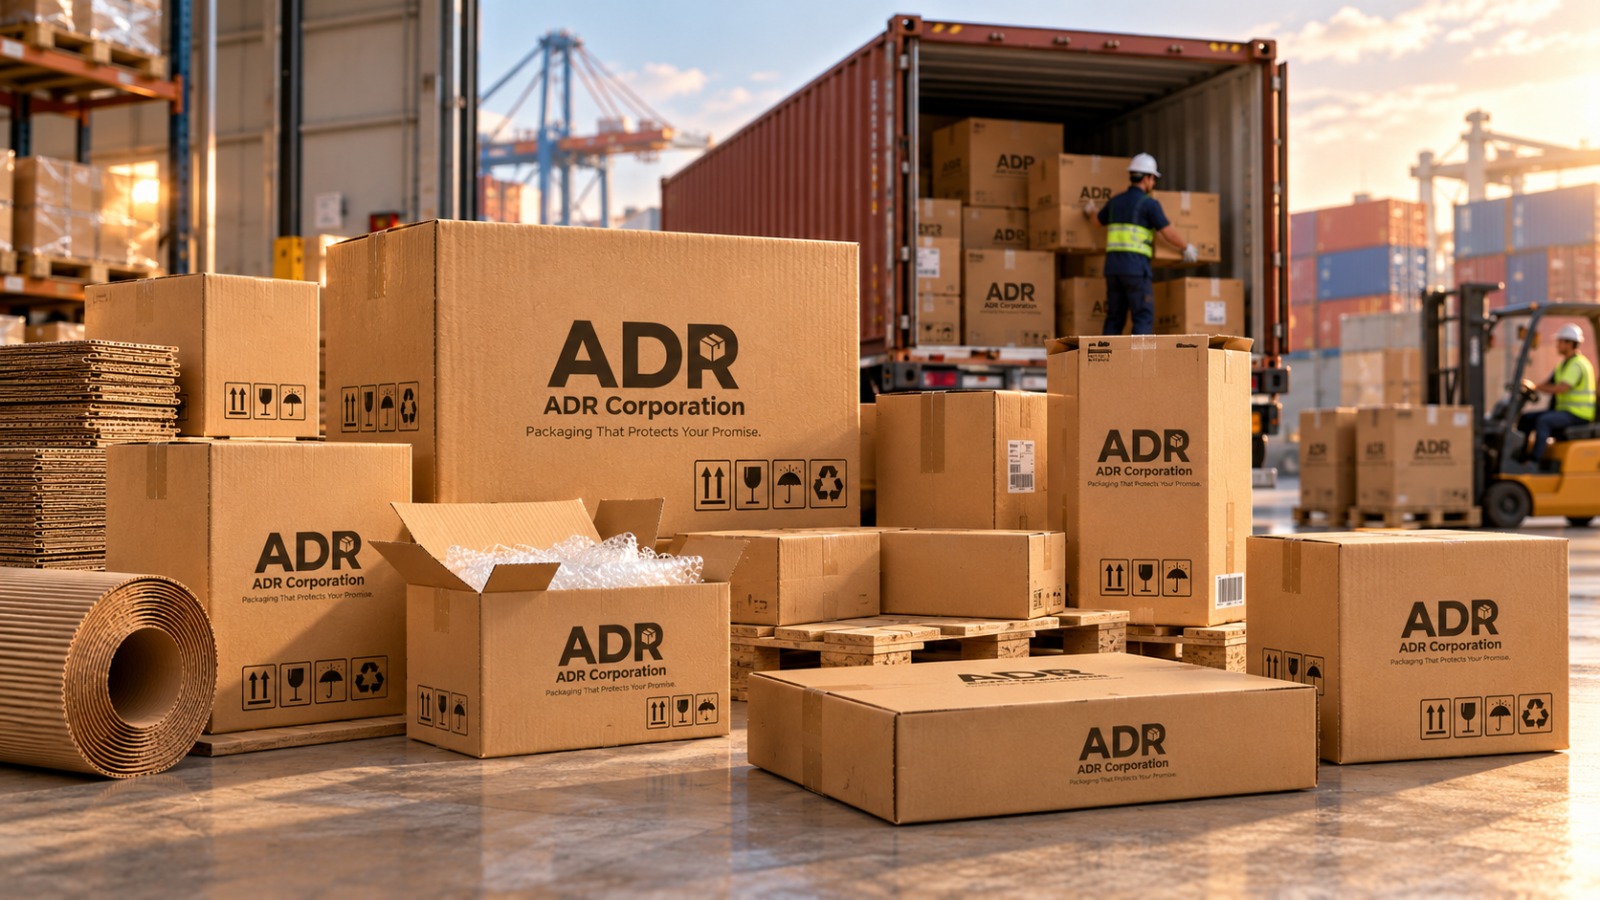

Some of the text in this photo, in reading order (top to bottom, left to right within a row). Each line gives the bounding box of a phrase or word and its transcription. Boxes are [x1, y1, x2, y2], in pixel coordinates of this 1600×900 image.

[986, 282, 1035, 301] ADR
[547, 320, 740, 390] ADR
[543, 396, 745, 420] ADR Corporation
[526, 426, 762, 440] Packaging That Protects Your Promise.
[1097, 429, 1190, 462] ADR
[1414, 440, 1451, 454] ADR
[1096, 466, 1192, 478] ADR Corporation
[254, 530, 362, 573] ADR
[252, 574, 364, 590] ADR Corporation
[242, 596, 278, 604] Packaging
[280, 594, 296, 602] That
[328, 592, 342, 600] Your
[1401, 599, 1499, 638] ADR
[558, 622, 664, 666] ADR
[1399, 639, 1502, 653] ADR Corporation
[1390, 658, 1424, 666] Packaging
[556, 665, 666, 683] ADR Corporation
[957, 668, 1094, 682] ADR
[546, 688, 582, 697] Packaging
[601, 685, 629, 693] Protects
[1079, 723, 1166, 761] ADR
[1077, 758, 1169, 774] ADR Corporation
